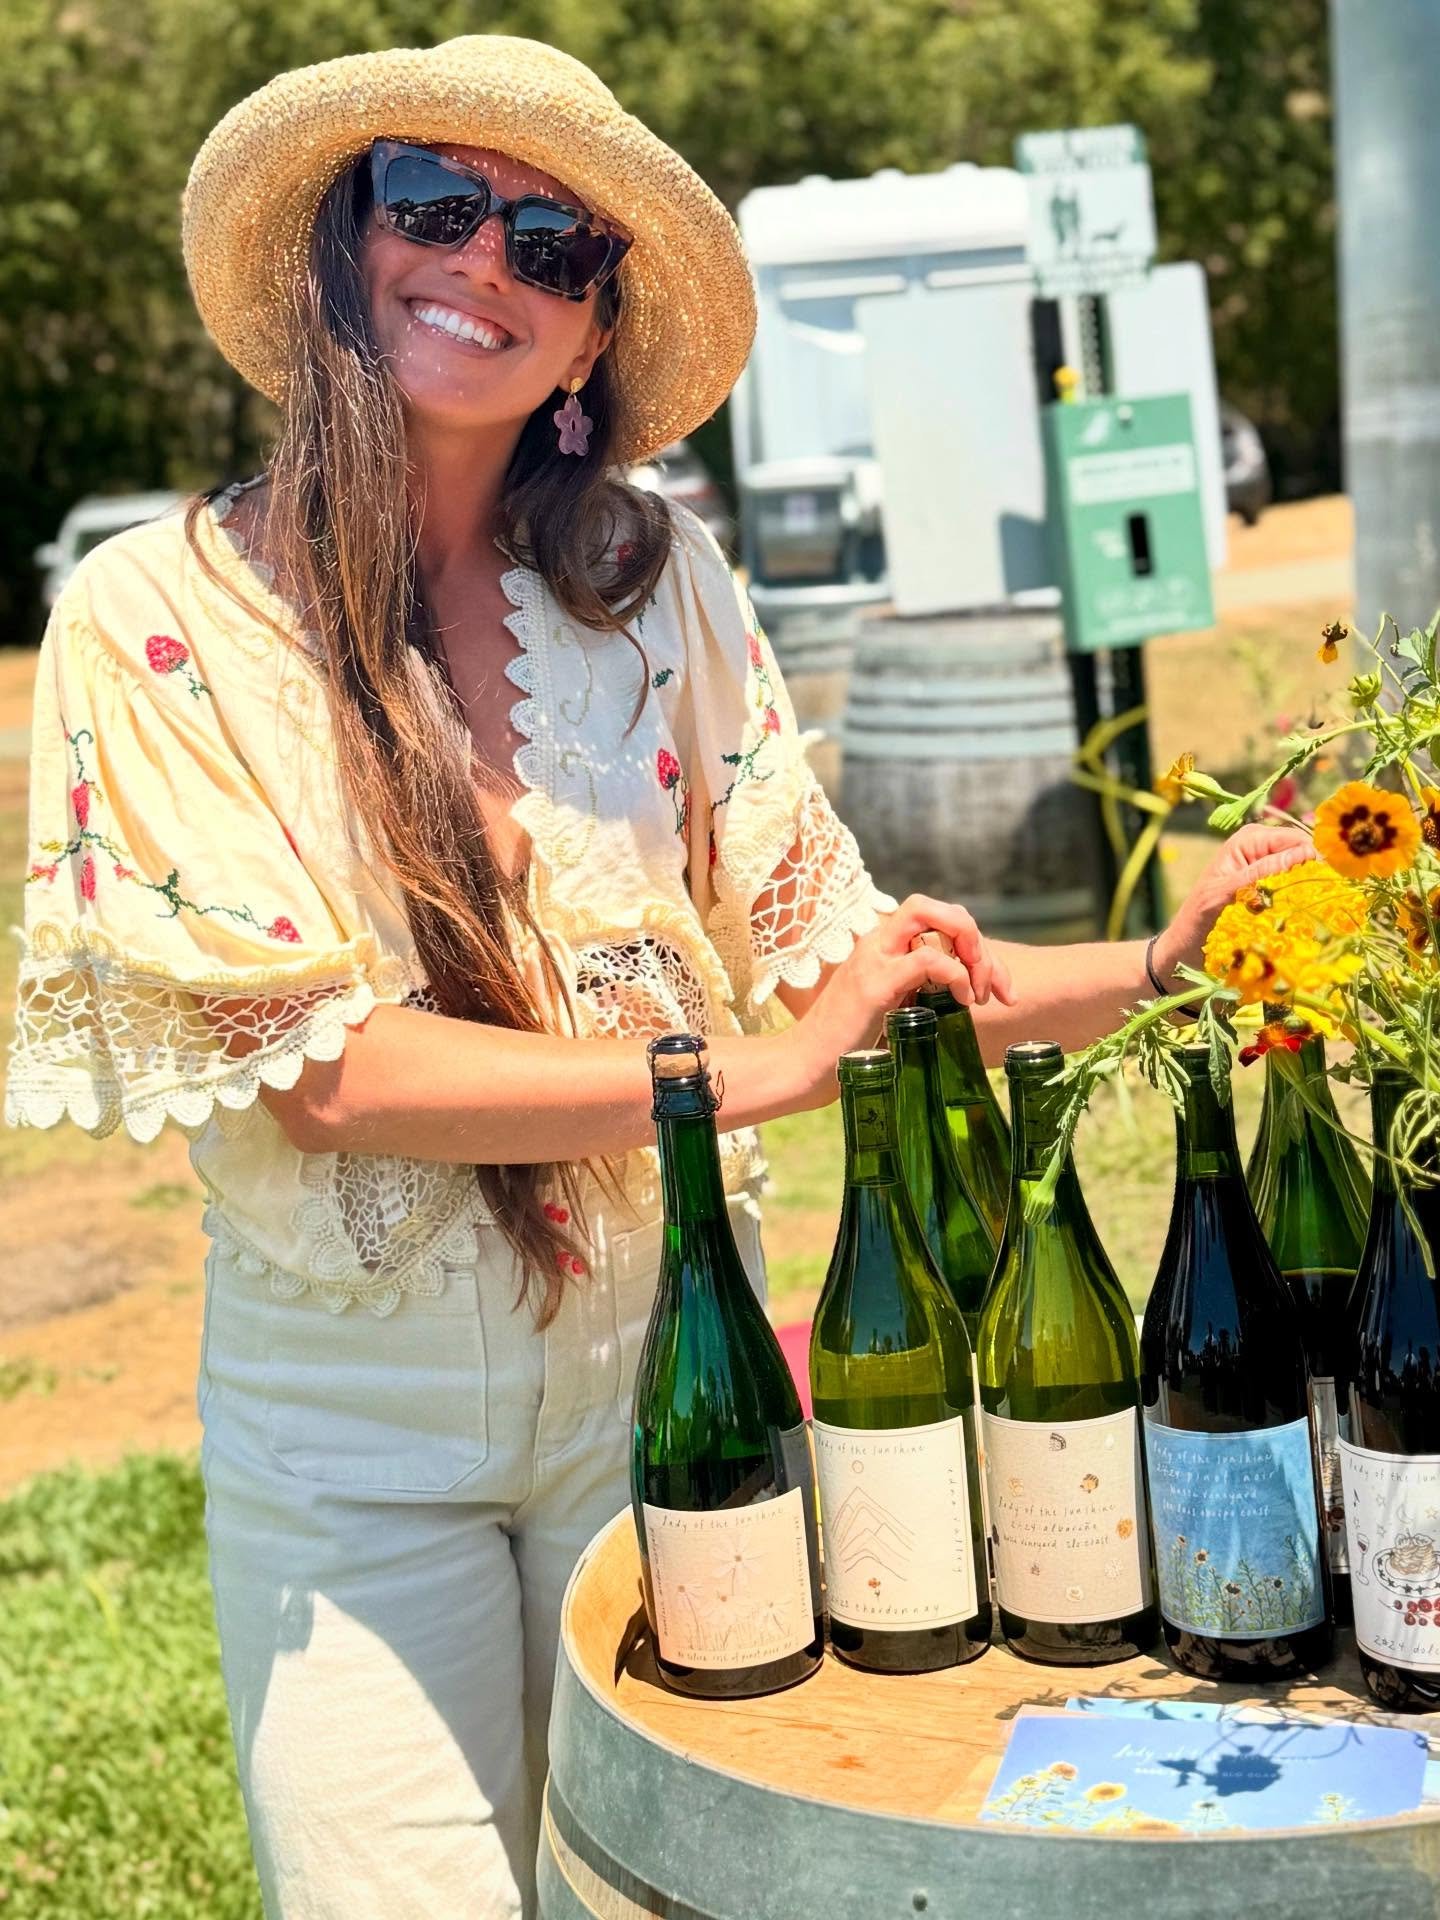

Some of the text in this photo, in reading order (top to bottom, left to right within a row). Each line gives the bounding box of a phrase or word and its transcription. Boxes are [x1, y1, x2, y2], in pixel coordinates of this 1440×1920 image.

[838, 1443, 846, 1454] of
[851, 1445, 867, 1456] the
[1153, 1440, 1172, 1463] lady
[1178, 1451, 1187, 1463] of
[1193, 1453, 1210, 1464] the
[1187, 1470, 1229, 1484] pinot
[1243, 1470, 1275, 1482] noir
[1347, 1457, 1369, 1480] lady
[1375, 1468, 1385, 1480] of
[1391, 1471, 1409, 1482] the
[999, 1497, 1018, 1516] lady
[1025, 1505, 1034, 1515] of
[1040, 1505, 1057, 1517] the
[1241, 1504, 1272, 1517] coast
[662, 1515, 688, 1533] lady
[694, 1519, 704, 1530] of
[710, 1518, 729, 1529] the
